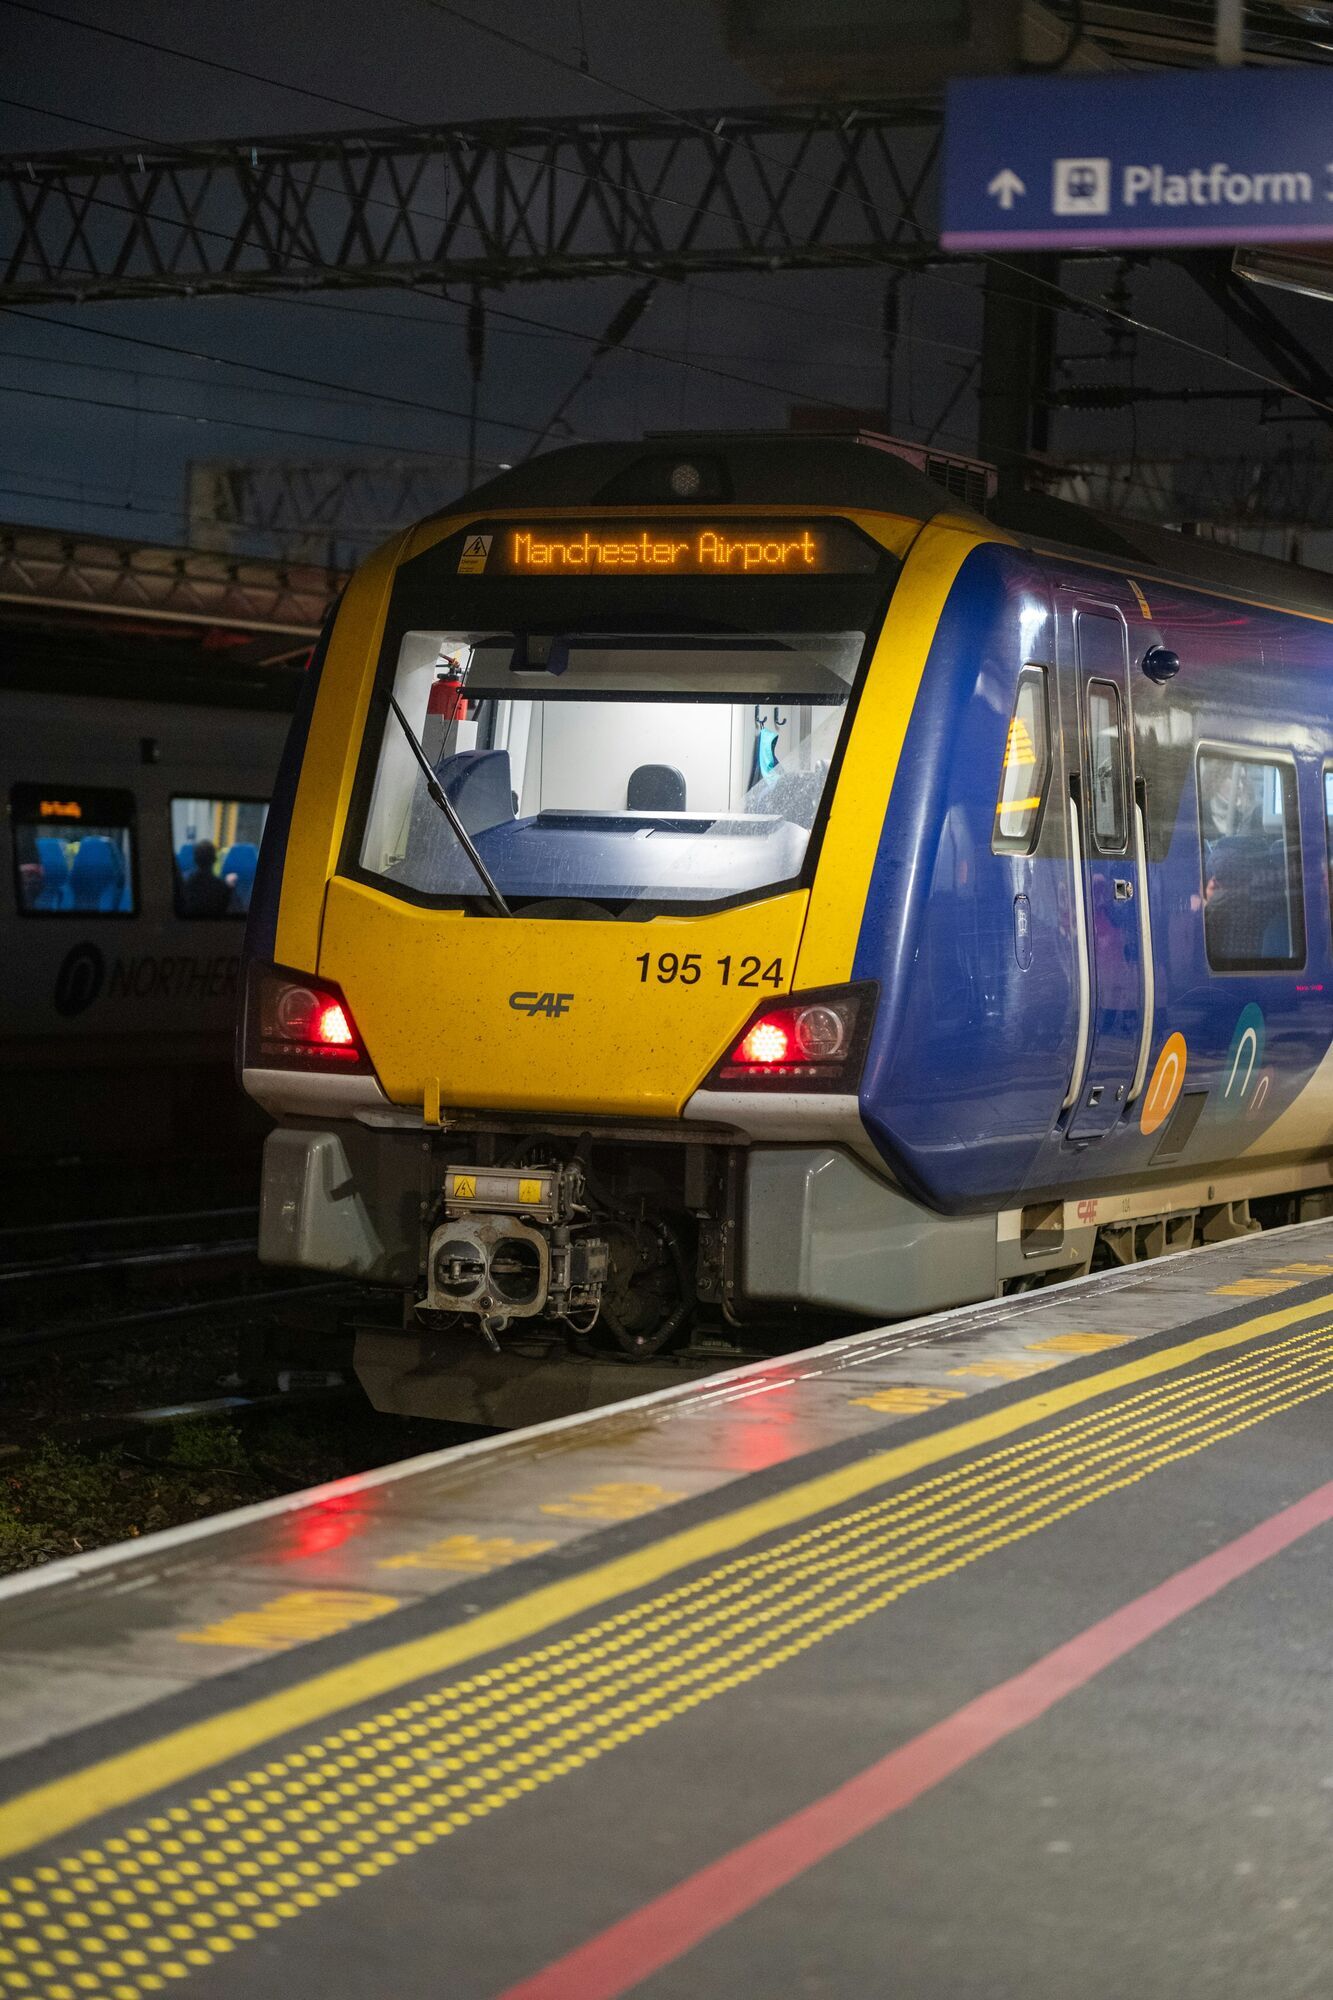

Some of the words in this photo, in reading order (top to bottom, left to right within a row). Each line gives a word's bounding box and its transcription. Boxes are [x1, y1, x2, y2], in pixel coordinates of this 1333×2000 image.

[1123, 162, 1313, 207] Platform
[514, 532, 689, 564] Manchester
[699, 532, 815, 570] Airport
[635, 952, 702, 985] 195
[716, 955, 784, 989] 124
[508, 991, 575, 1018] CAF
[1077, 1199, 1098, 1224] CAF
